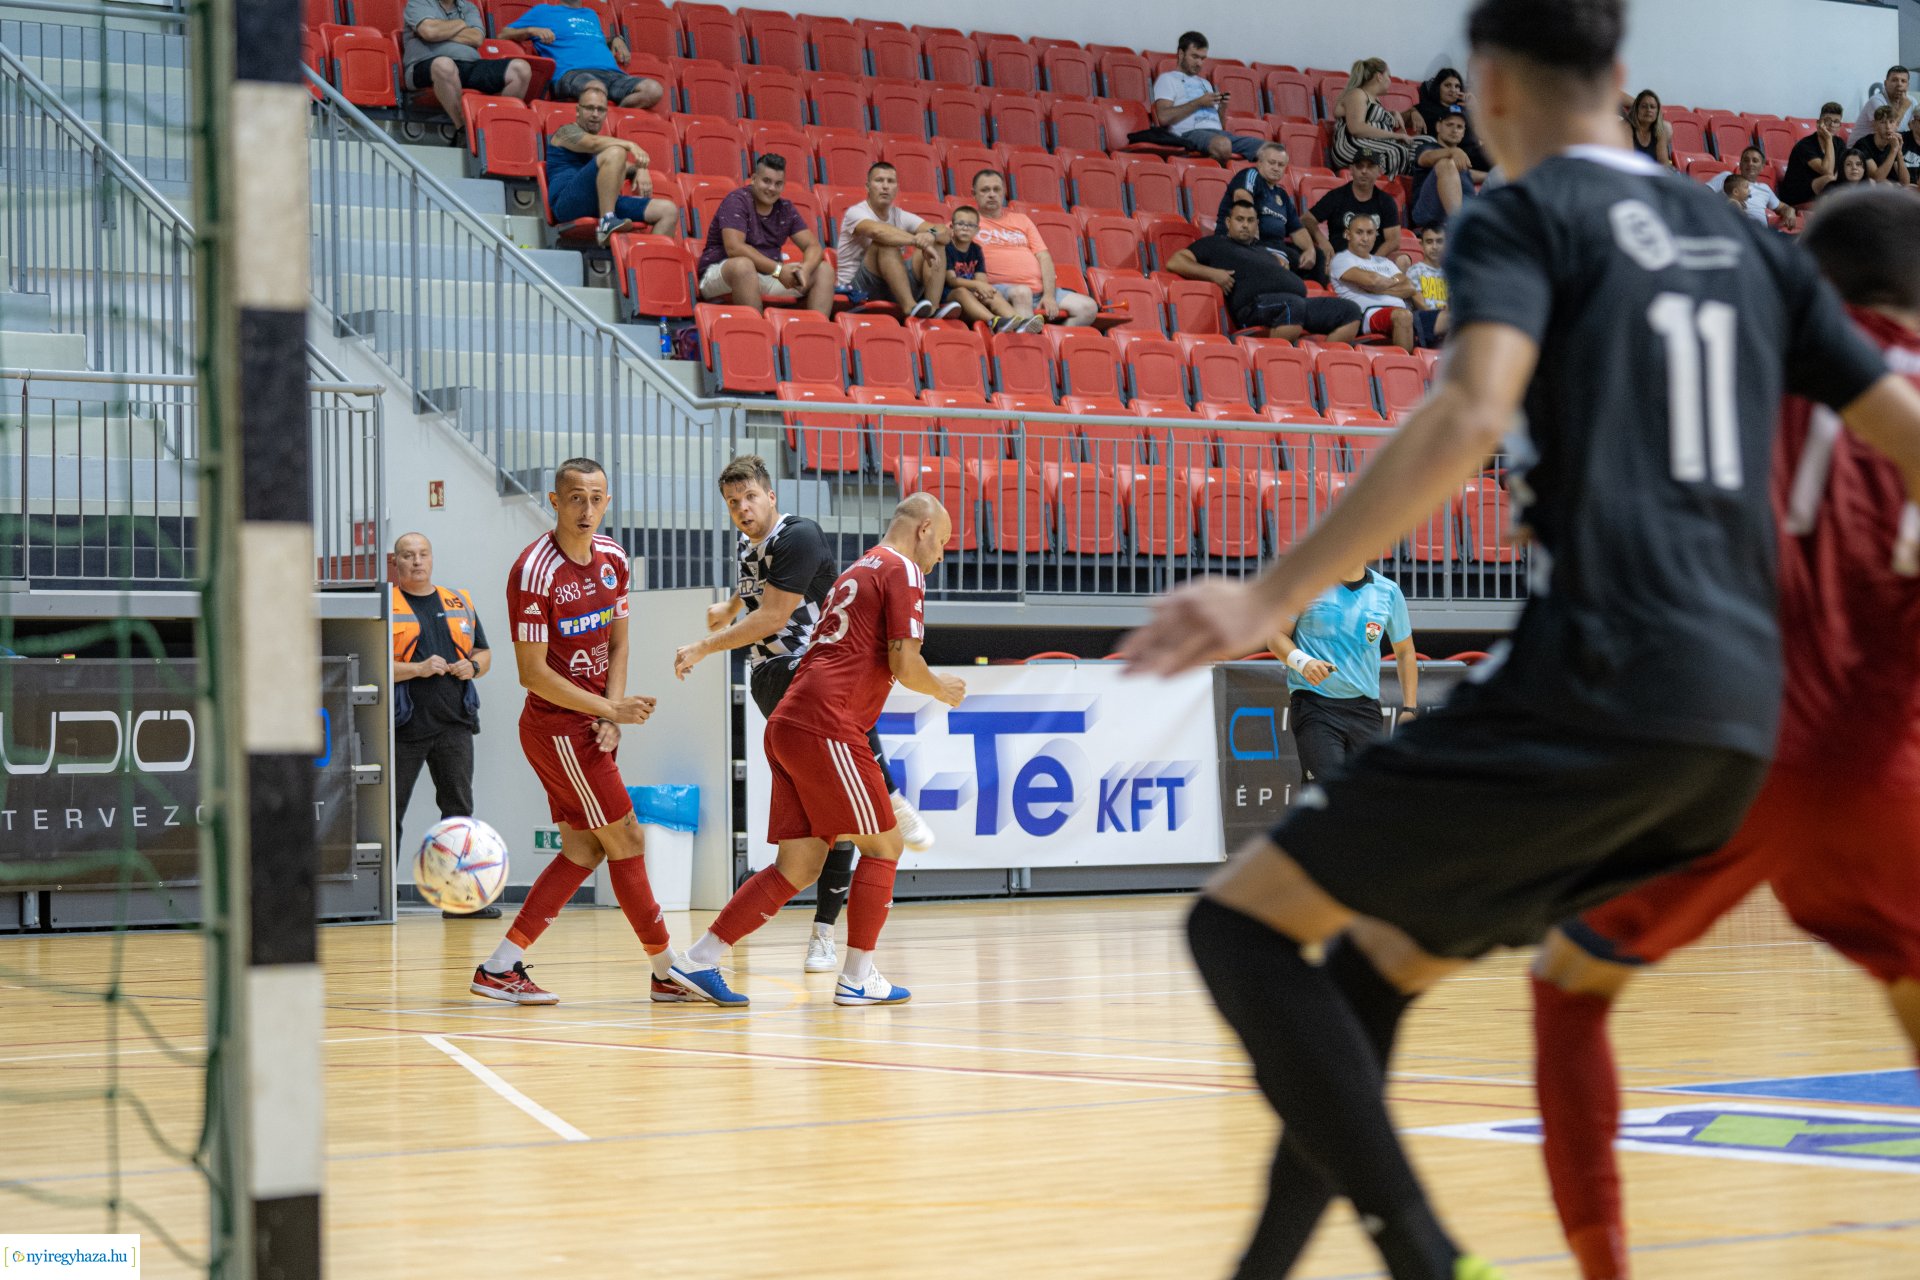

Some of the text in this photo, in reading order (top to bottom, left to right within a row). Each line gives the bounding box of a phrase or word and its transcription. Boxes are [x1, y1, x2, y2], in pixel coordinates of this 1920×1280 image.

[1648, 292, 1744, 490] 11
[555, 582, 581, 605] 383
[1096, 776, 1186, 833] KFT
